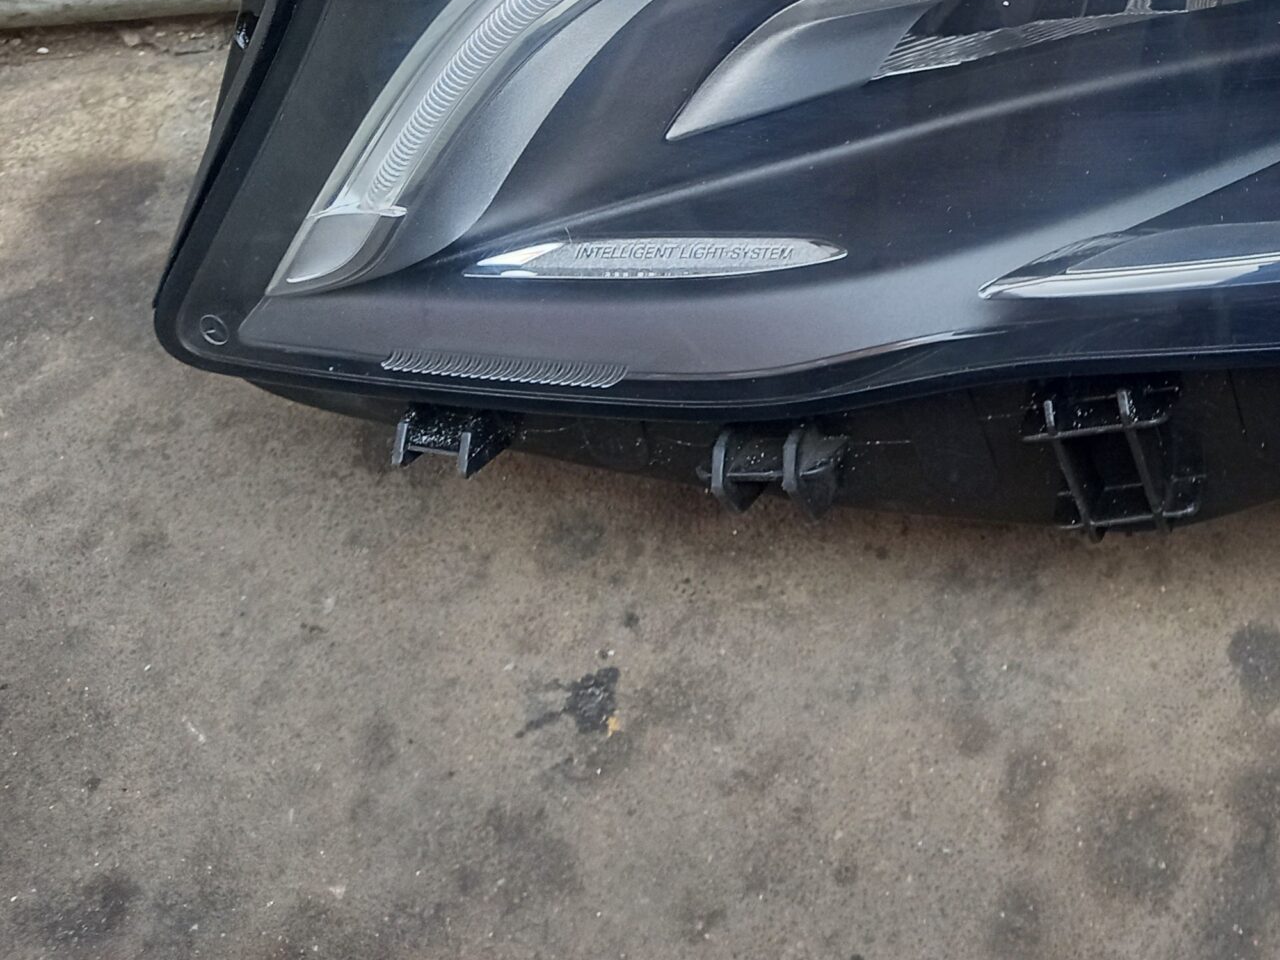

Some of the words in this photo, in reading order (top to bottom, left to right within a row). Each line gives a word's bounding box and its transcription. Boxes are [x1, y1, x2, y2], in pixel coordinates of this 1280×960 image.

[574, 242, 677, 261] INTELLIGENT
[678, 243, 727, 261] LIGHT
[729, 245, 795, 261] SYSTEM
